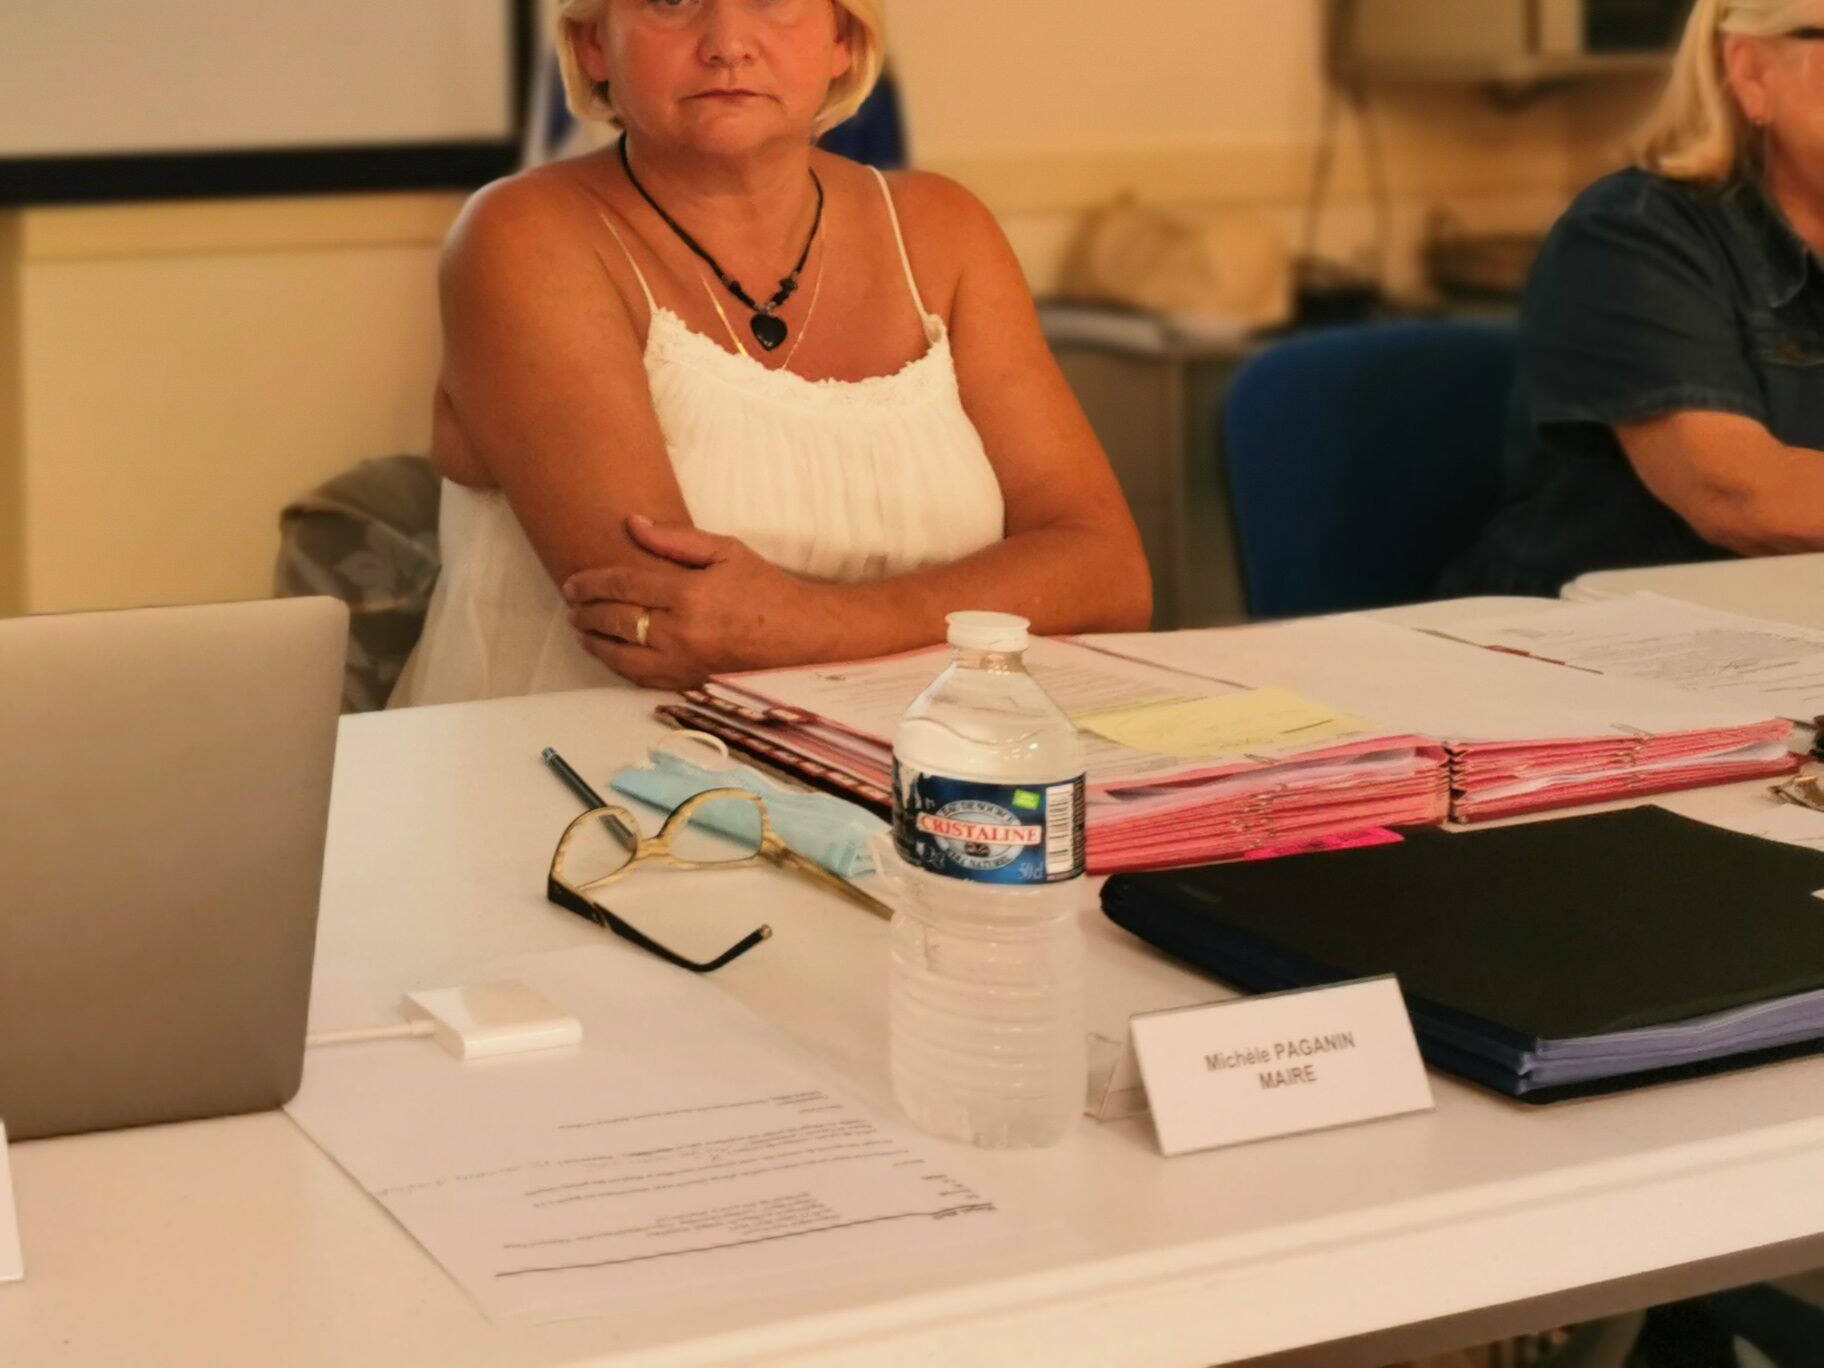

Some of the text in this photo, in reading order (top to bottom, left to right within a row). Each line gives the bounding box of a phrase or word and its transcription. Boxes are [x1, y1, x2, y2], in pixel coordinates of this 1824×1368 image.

[921, 814, 1038, 843] CRISTALINE
[1203, 1030, 1357, 1073] Michèle PAGANIN
[1258, 1063, 1320, 1091] MAIRE
